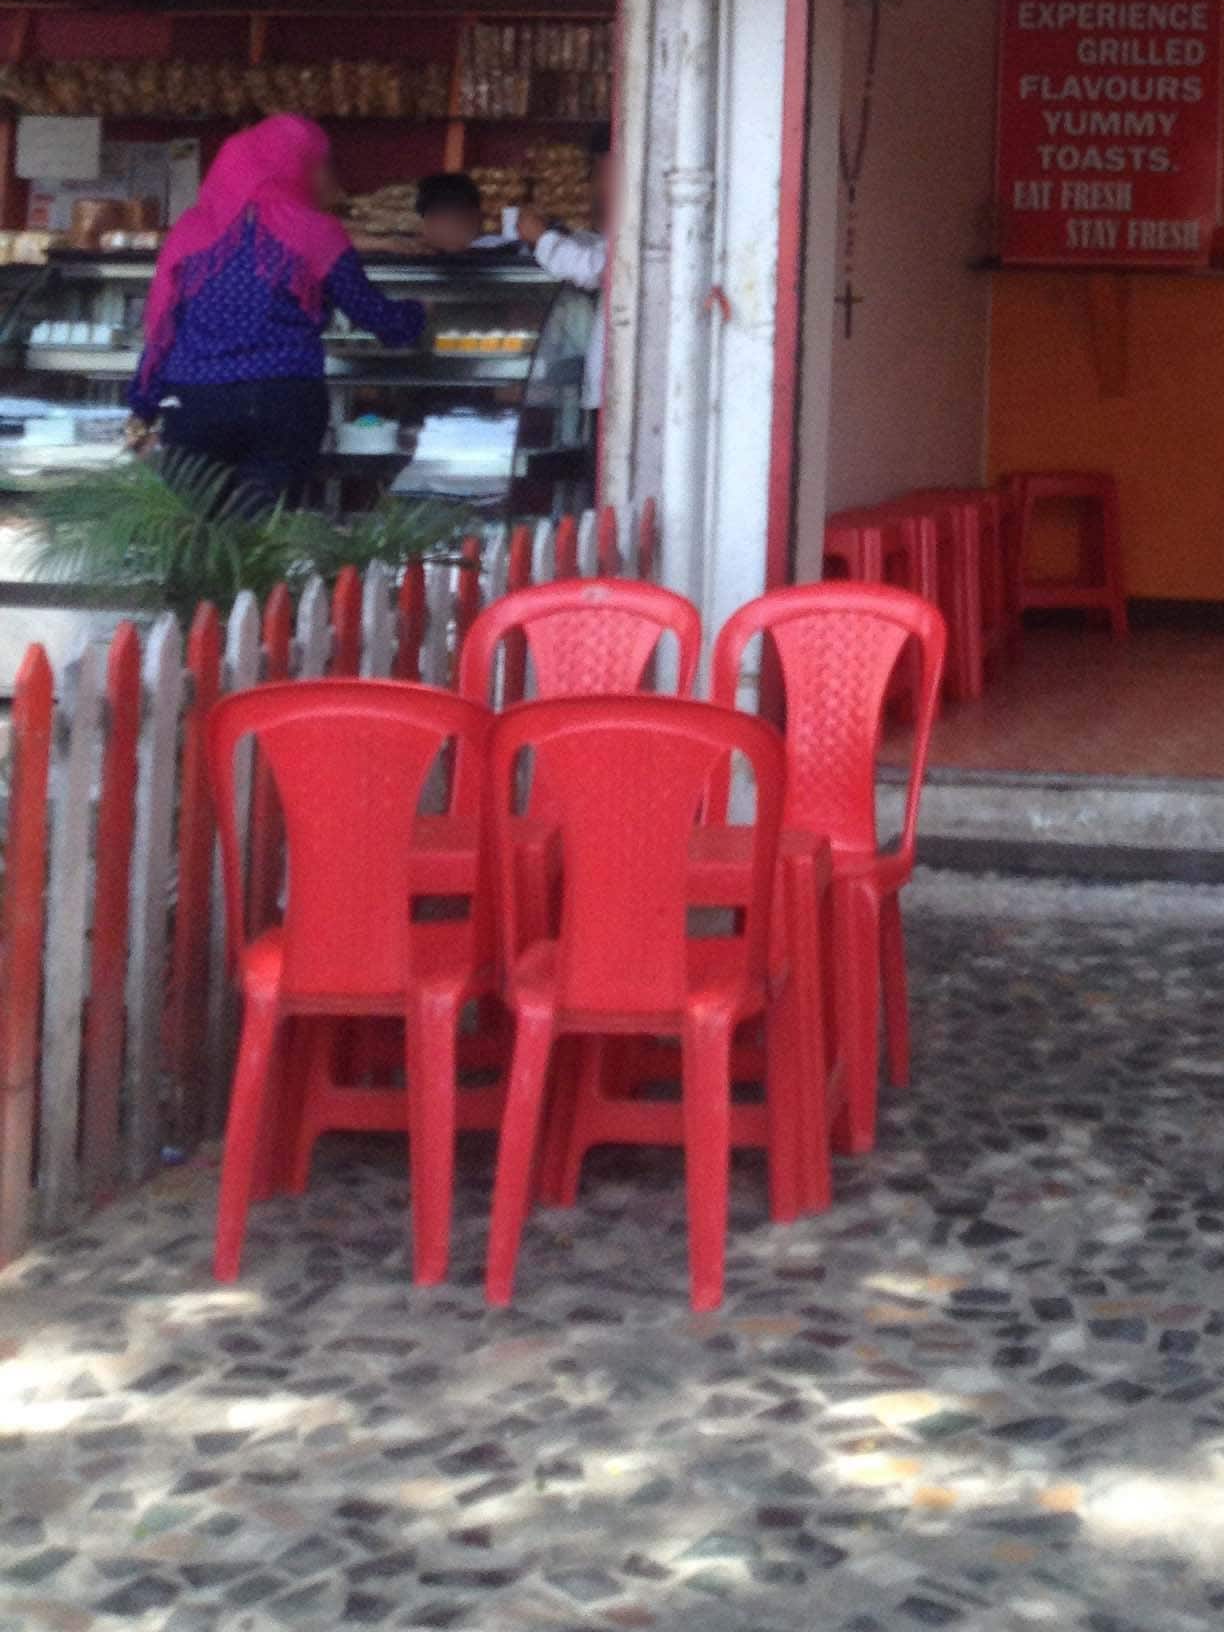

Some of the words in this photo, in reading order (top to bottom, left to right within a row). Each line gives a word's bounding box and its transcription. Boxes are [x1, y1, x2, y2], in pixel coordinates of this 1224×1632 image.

[1019, 2, 1208, 30] EXPERIENCE
[1077, 39, 1206, 66] GRILLED
[1020, 75, 1202, 102] FLAVOURS
[1043, 111, 1177, 137] YUMMY
[1013, 181, 1053, 211] EAT
[1061, 180, 1134, 211] FRESH
[1067, 218, 1121, 250] STAY
[1127, 218, 1201, 250] FRESH
